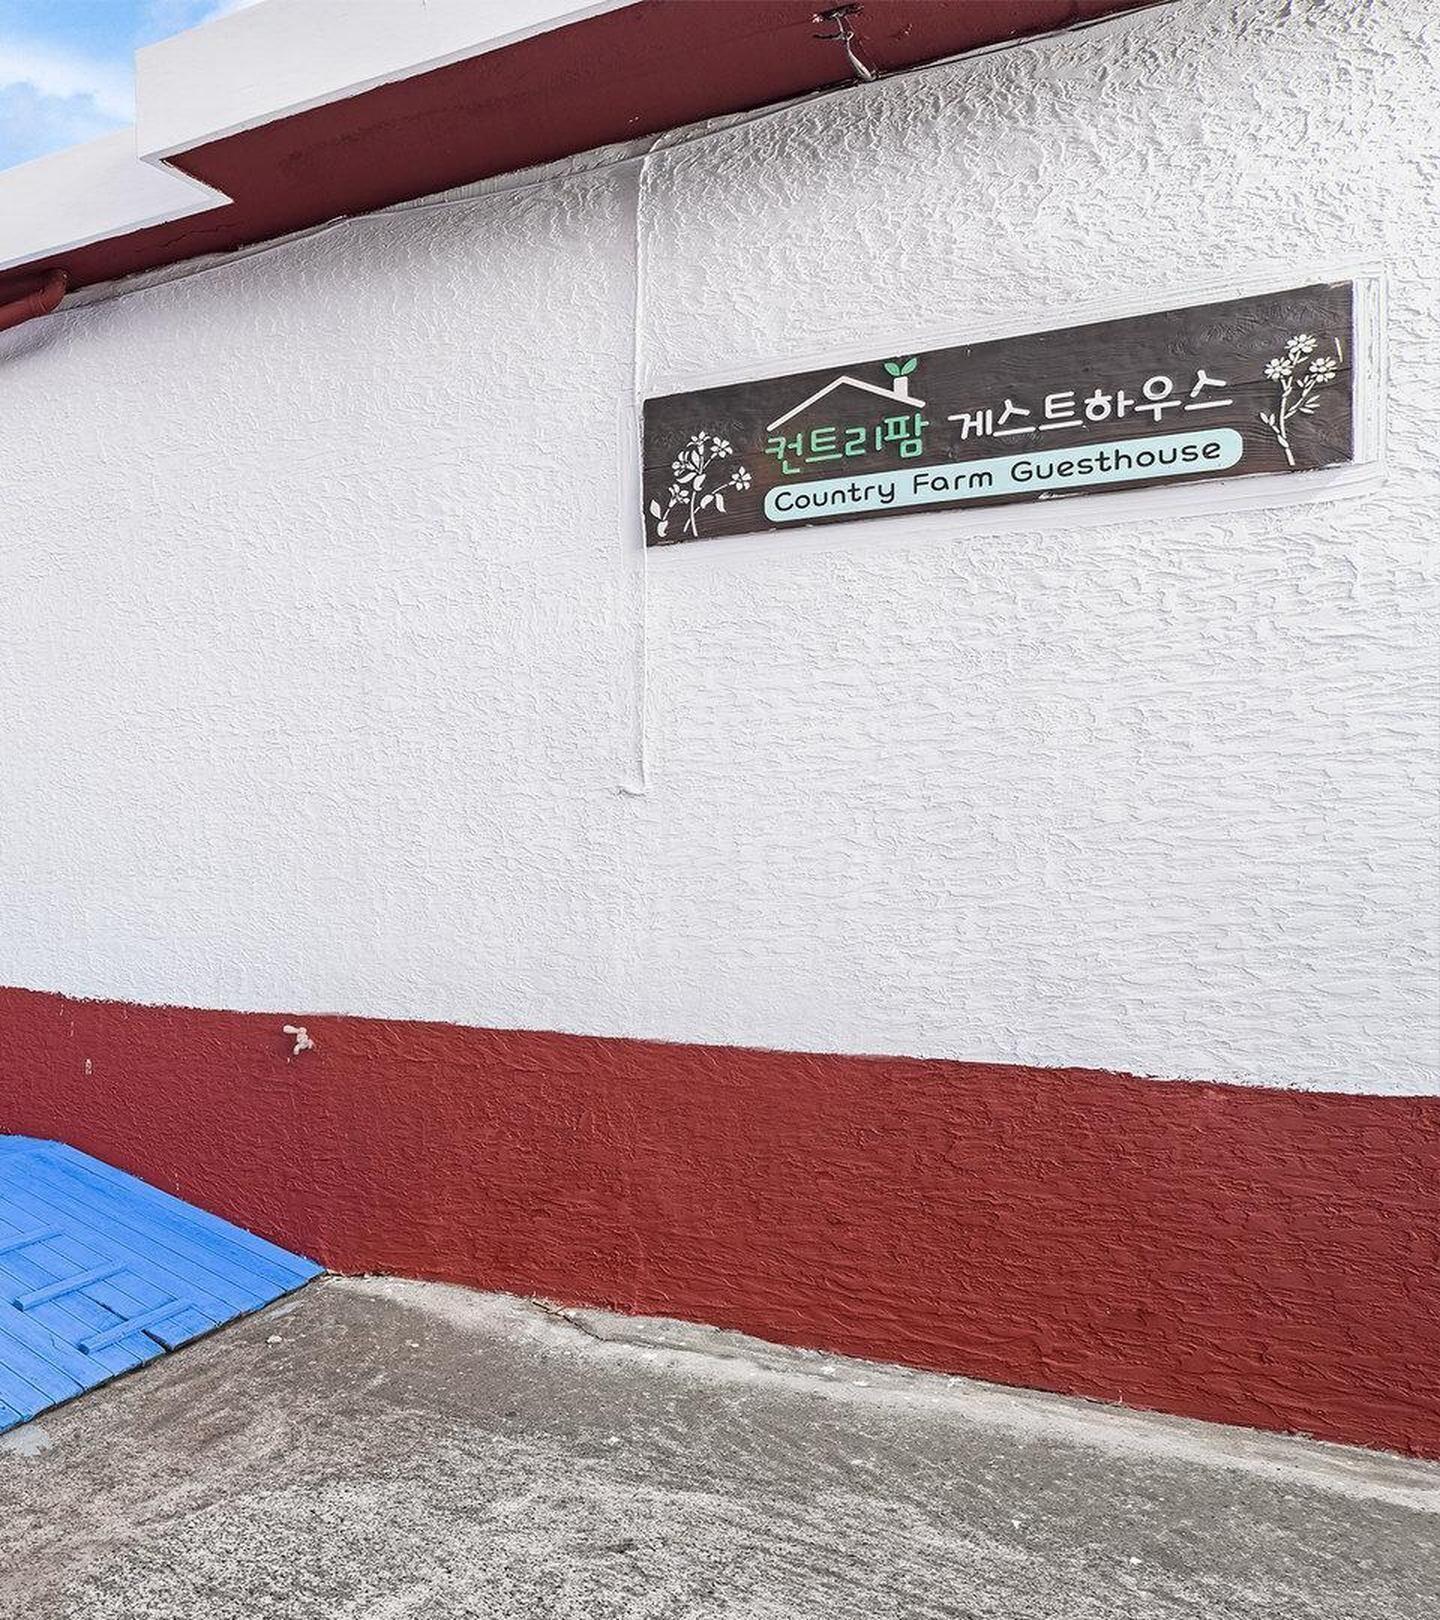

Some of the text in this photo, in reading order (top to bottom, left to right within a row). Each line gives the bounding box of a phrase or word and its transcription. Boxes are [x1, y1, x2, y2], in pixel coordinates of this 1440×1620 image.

[765, 370, 1233, 475] 컨트리팜 게스트하우스
[774, 441, 1221, 512] Country Farm Guesthouse
